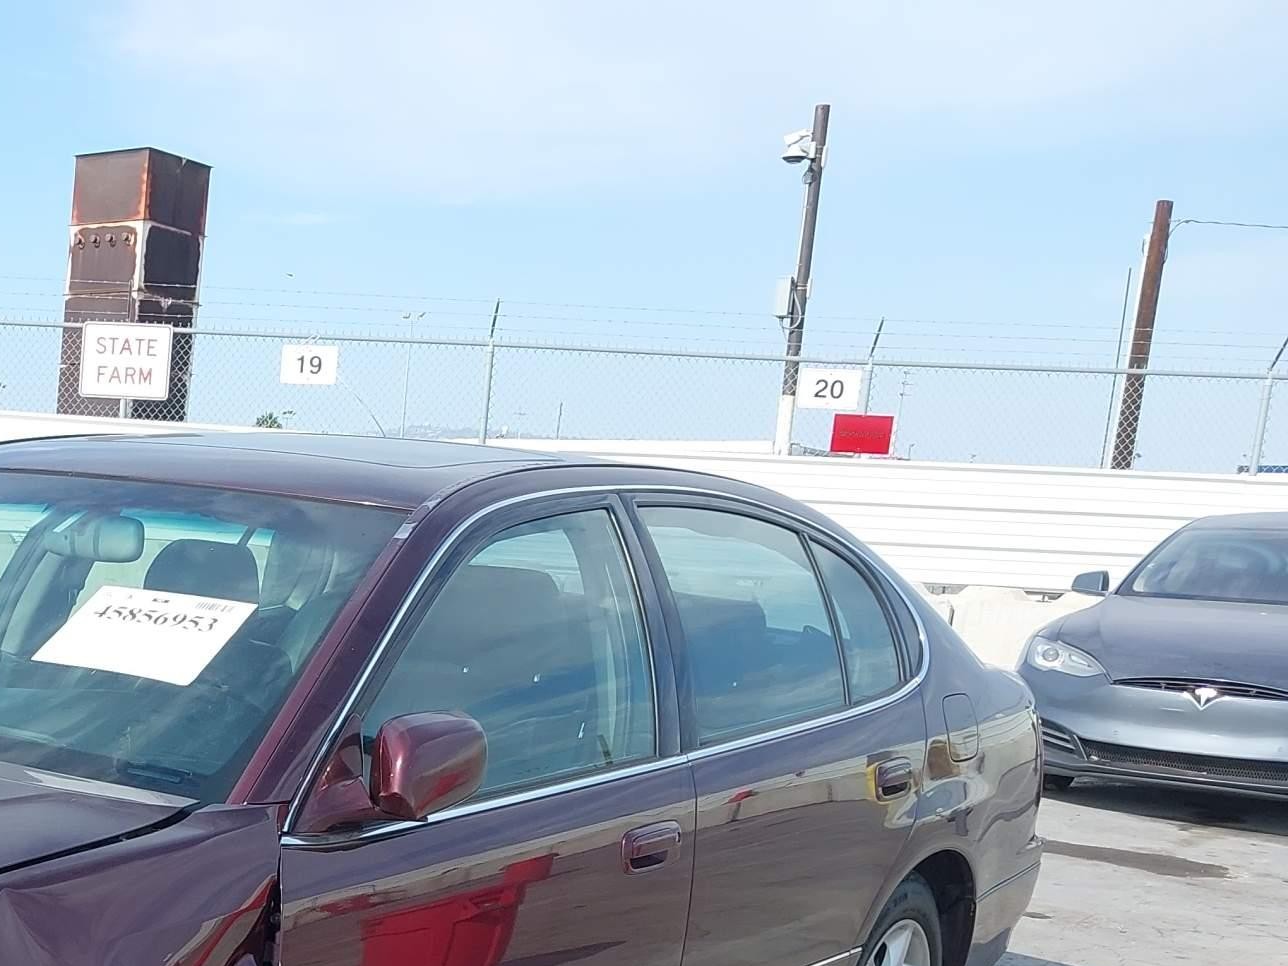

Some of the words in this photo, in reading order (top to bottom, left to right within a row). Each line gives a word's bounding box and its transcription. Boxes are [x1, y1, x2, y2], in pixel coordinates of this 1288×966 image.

[96, 336, 158, 357] STATE
[96, 365, 153, 385] FARM
[297, 355, 322, 375] 19
[814, 379, 844, 399] 20
[94, 604, 219, 632] 45856953
